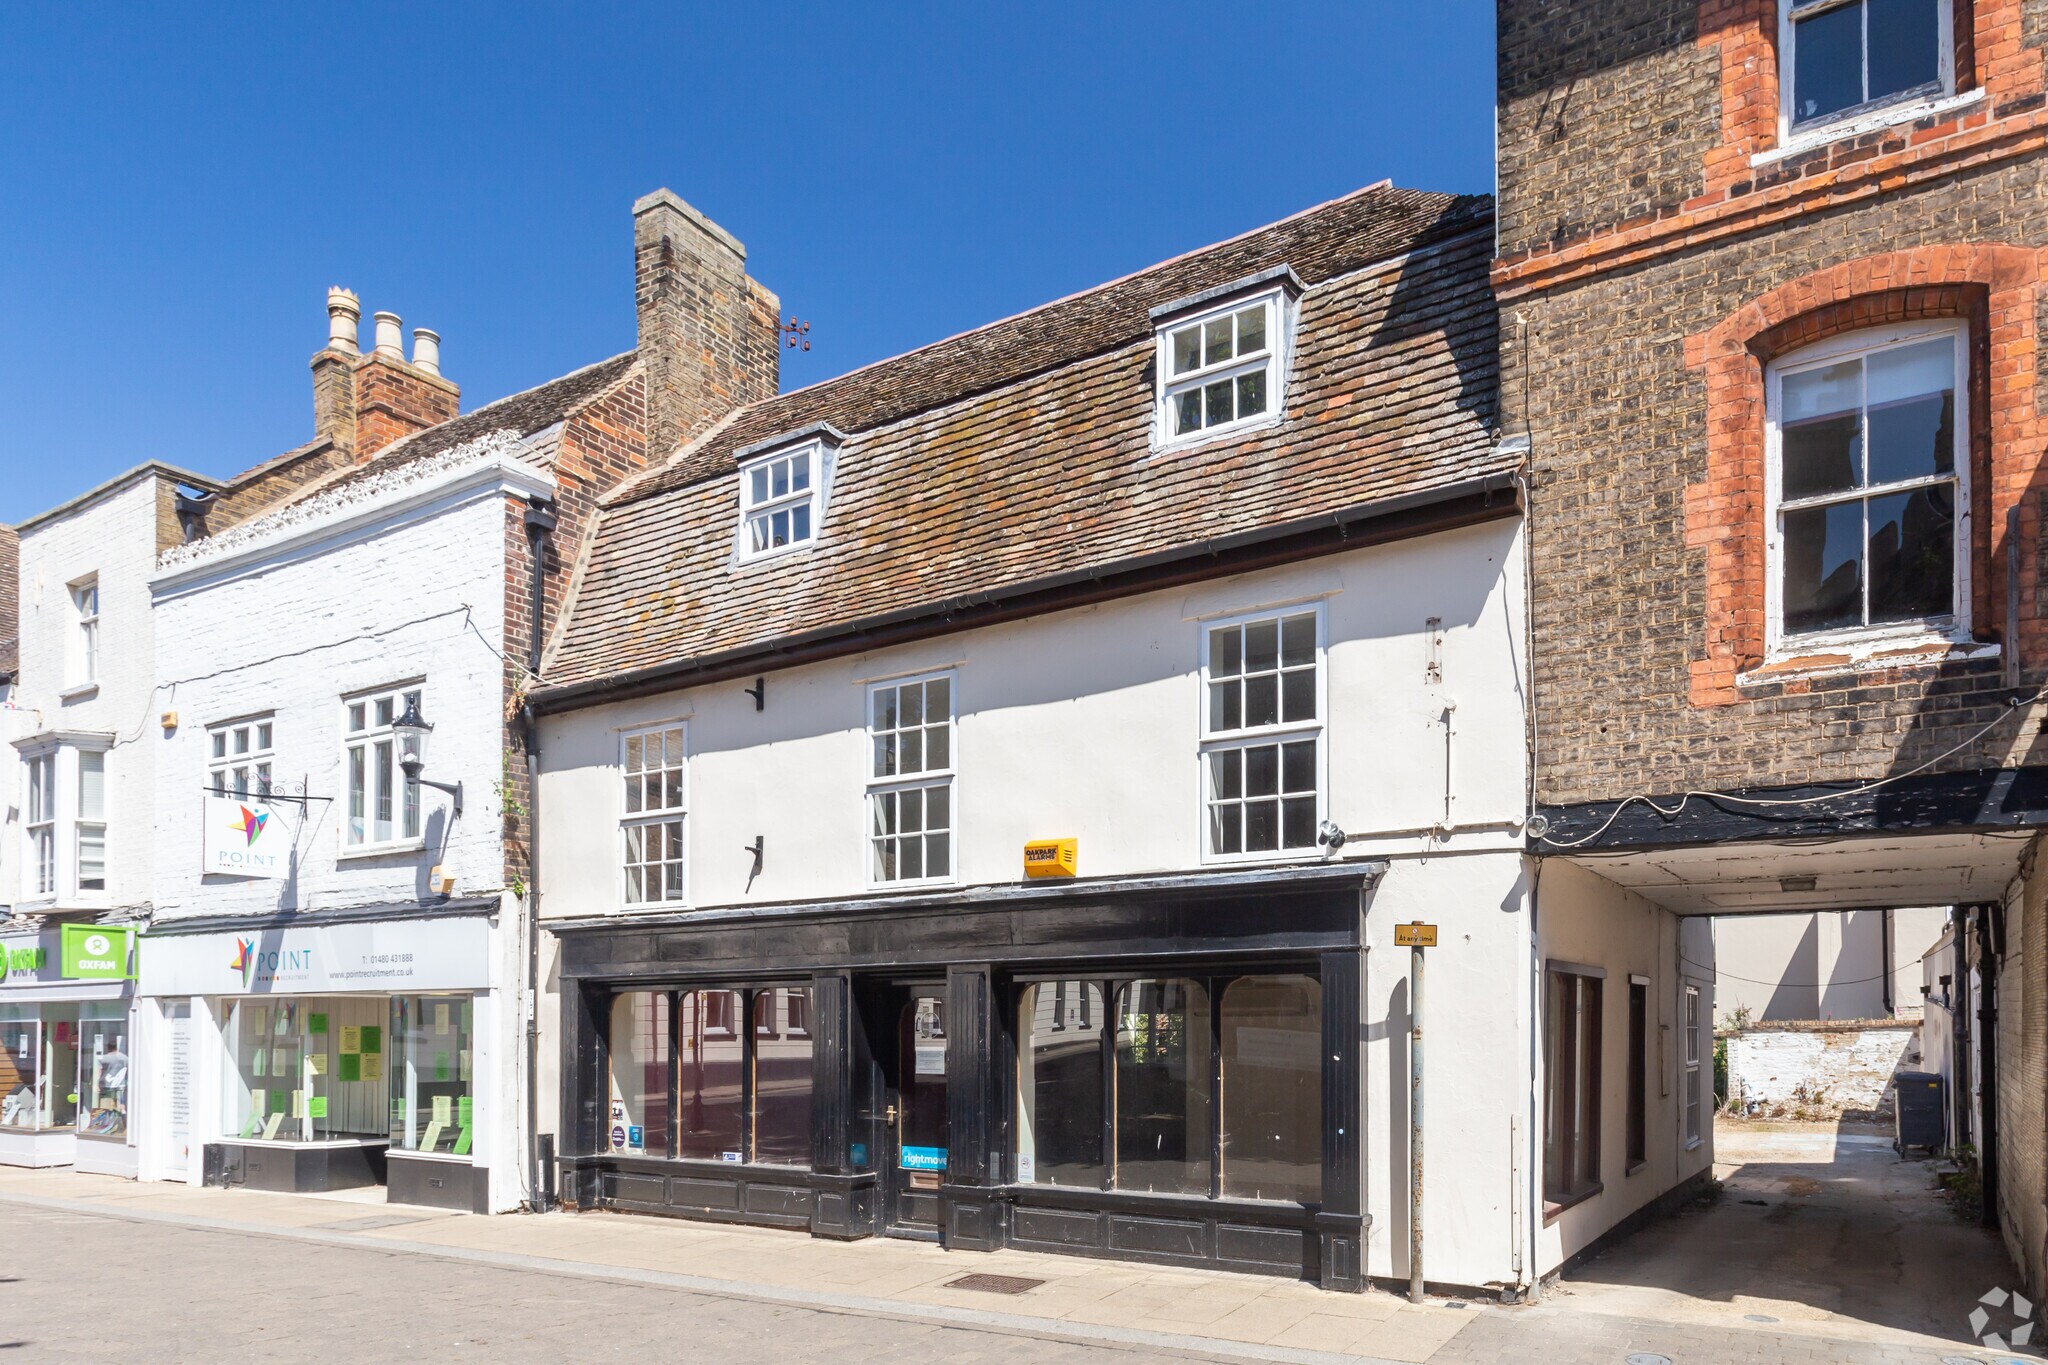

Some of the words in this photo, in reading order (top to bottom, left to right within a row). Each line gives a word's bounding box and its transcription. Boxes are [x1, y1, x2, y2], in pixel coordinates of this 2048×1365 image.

[1025, 847, 1057, 856] OAKPARK
[1028, 853, 1055, 861] ALARMS
[219, 851, 276, 866] POINT
[9, 947, 46, 970] OXFAM
[79, 959, 116, 970] OXFAM
[258, 949, 311, 972] POINT
[362, 955, 368, 964] T:
[370, 954, 389, 964] 01480
[390, 953, 413, 963] 431888
[329, 967, 414, 980] www.pointrecruitment.co.uk
[904, 1153, 947, 1166] rightmove
